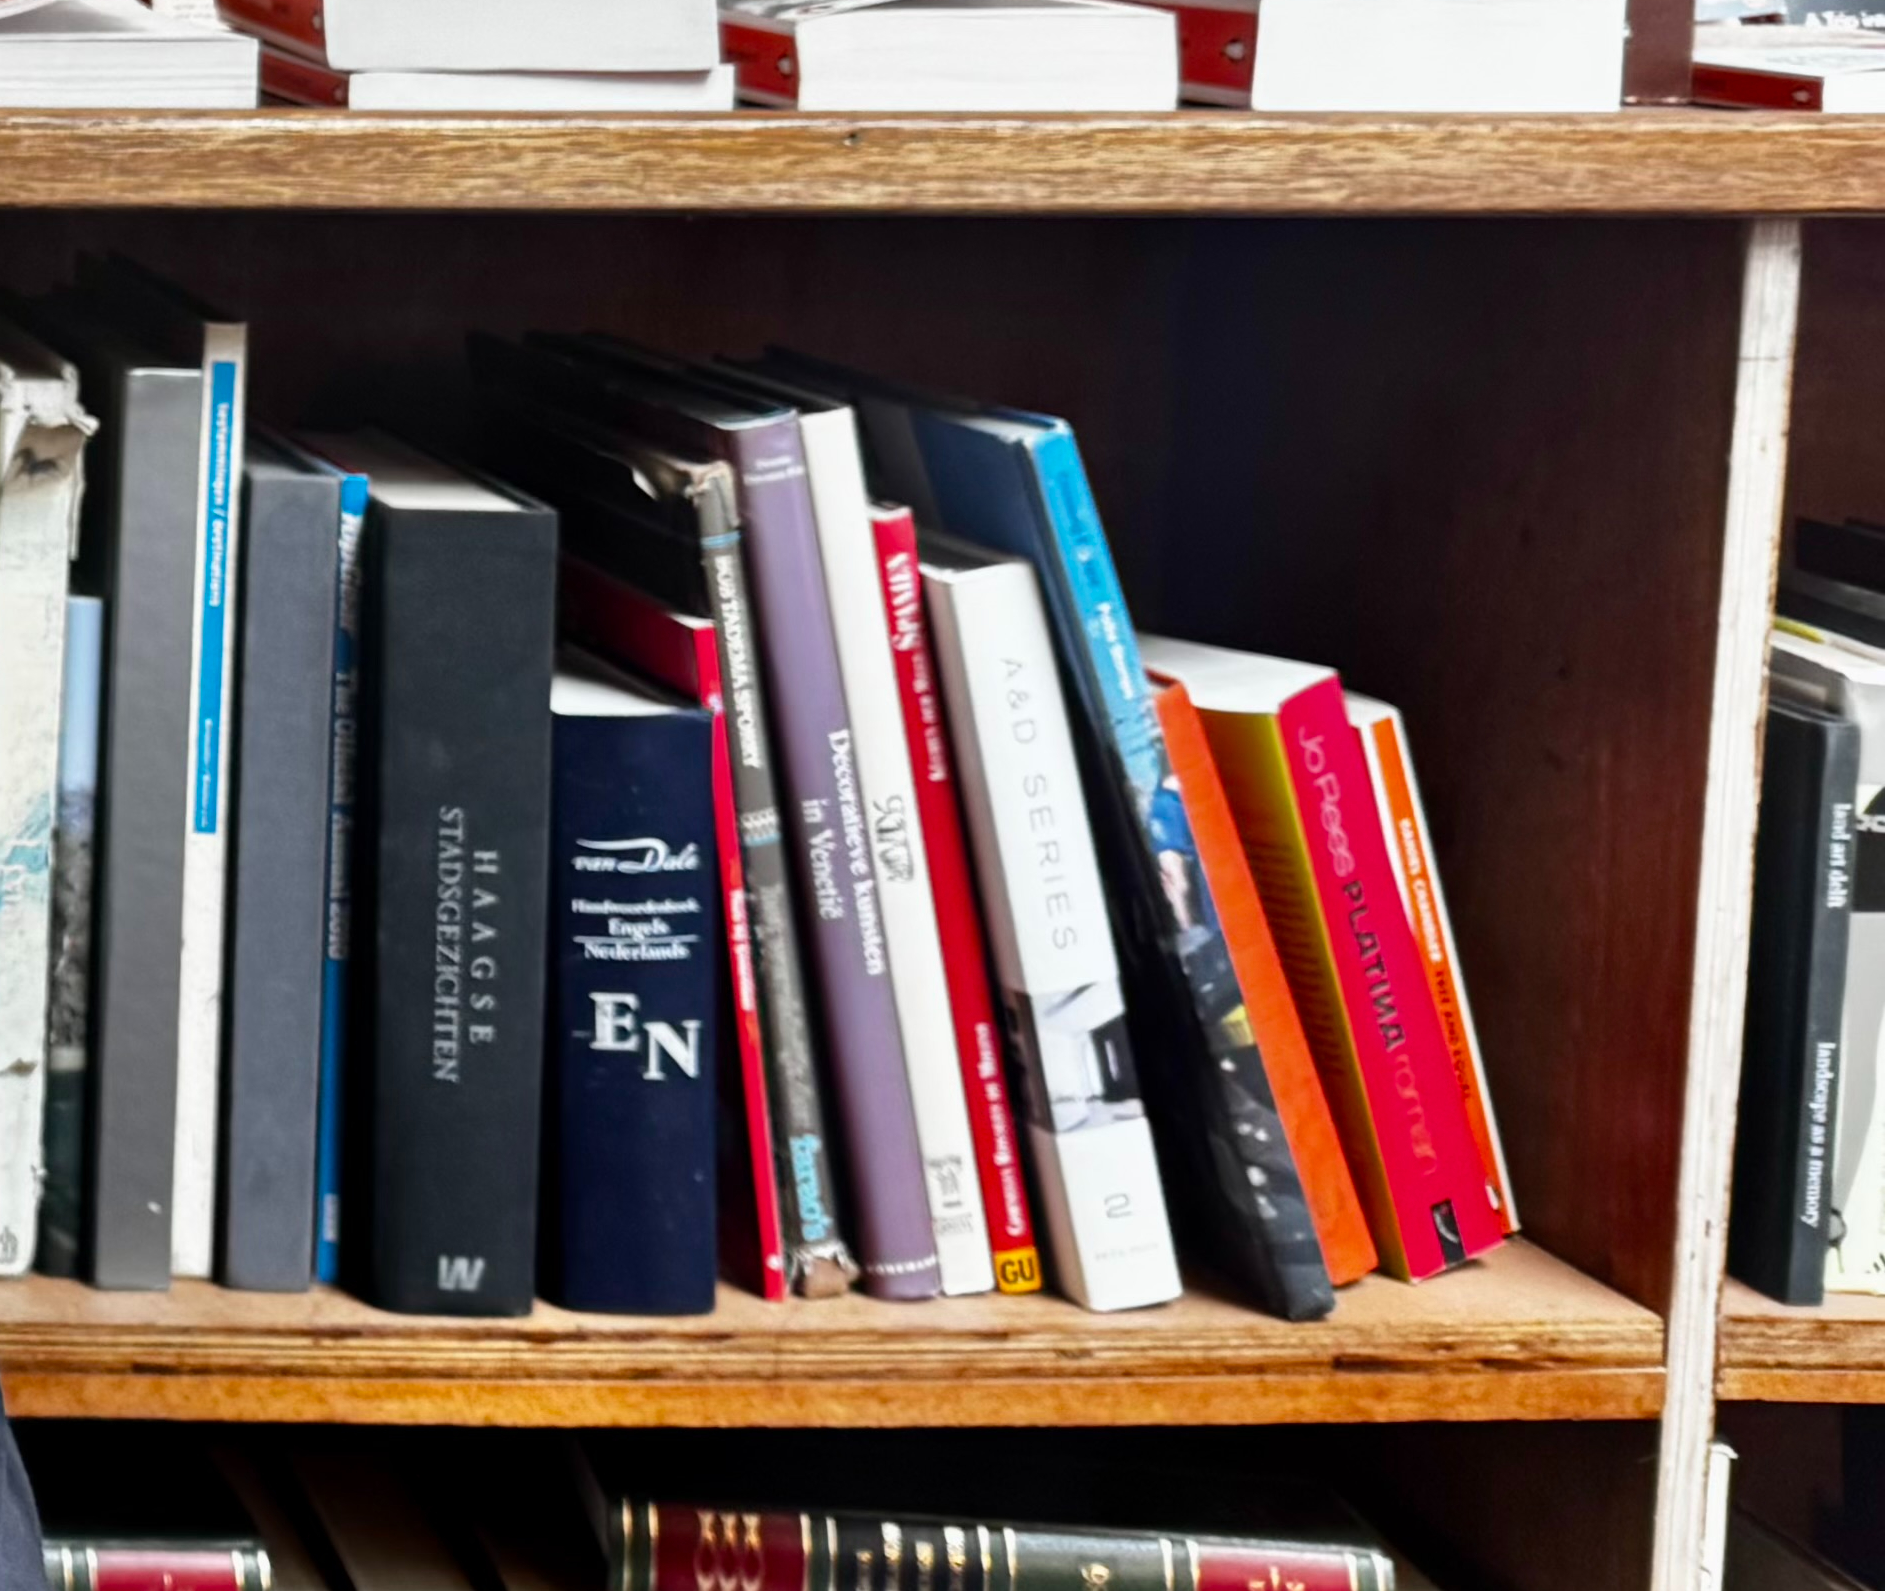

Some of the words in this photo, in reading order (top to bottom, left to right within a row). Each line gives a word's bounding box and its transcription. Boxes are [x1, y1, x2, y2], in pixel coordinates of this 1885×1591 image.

[336, 669, 358, 713] The
[801, 798, 830, 822] in
[1000, 656, 1038, 745] A&D
[1022, 773, 1078, 950] SERIES
[1314, 772, 1355, 877] Rees
[1831, 802, 1853, 840] land
[808, 828, 845, 920] Venetië
[828, 727, 870, 875] Decoratieve
[852, 878, 887, 975] kunsten
[1829, 843, 1849, 867] art
[1826, 869, 1849, 907] delft
[431, 805, 465, 1084] STADSGEZICHTEN
[468, 849, 501, 1045] HAAGSE
[584, 941, 692, 962] Nederlands
[608, 916, 671, 942] Engels
[1342, 879, 1406, 1051] PLATINA
[588, 991, 641, 1052] E
[642, 1019, 703, 1082] N
[1809, 1041, 1837, 1123] landscape
[1810, 1126, 1828, 1145] as
[1800, 1159, 1824, 1227] memory
[999, 1255, 1036, 1285] GU
